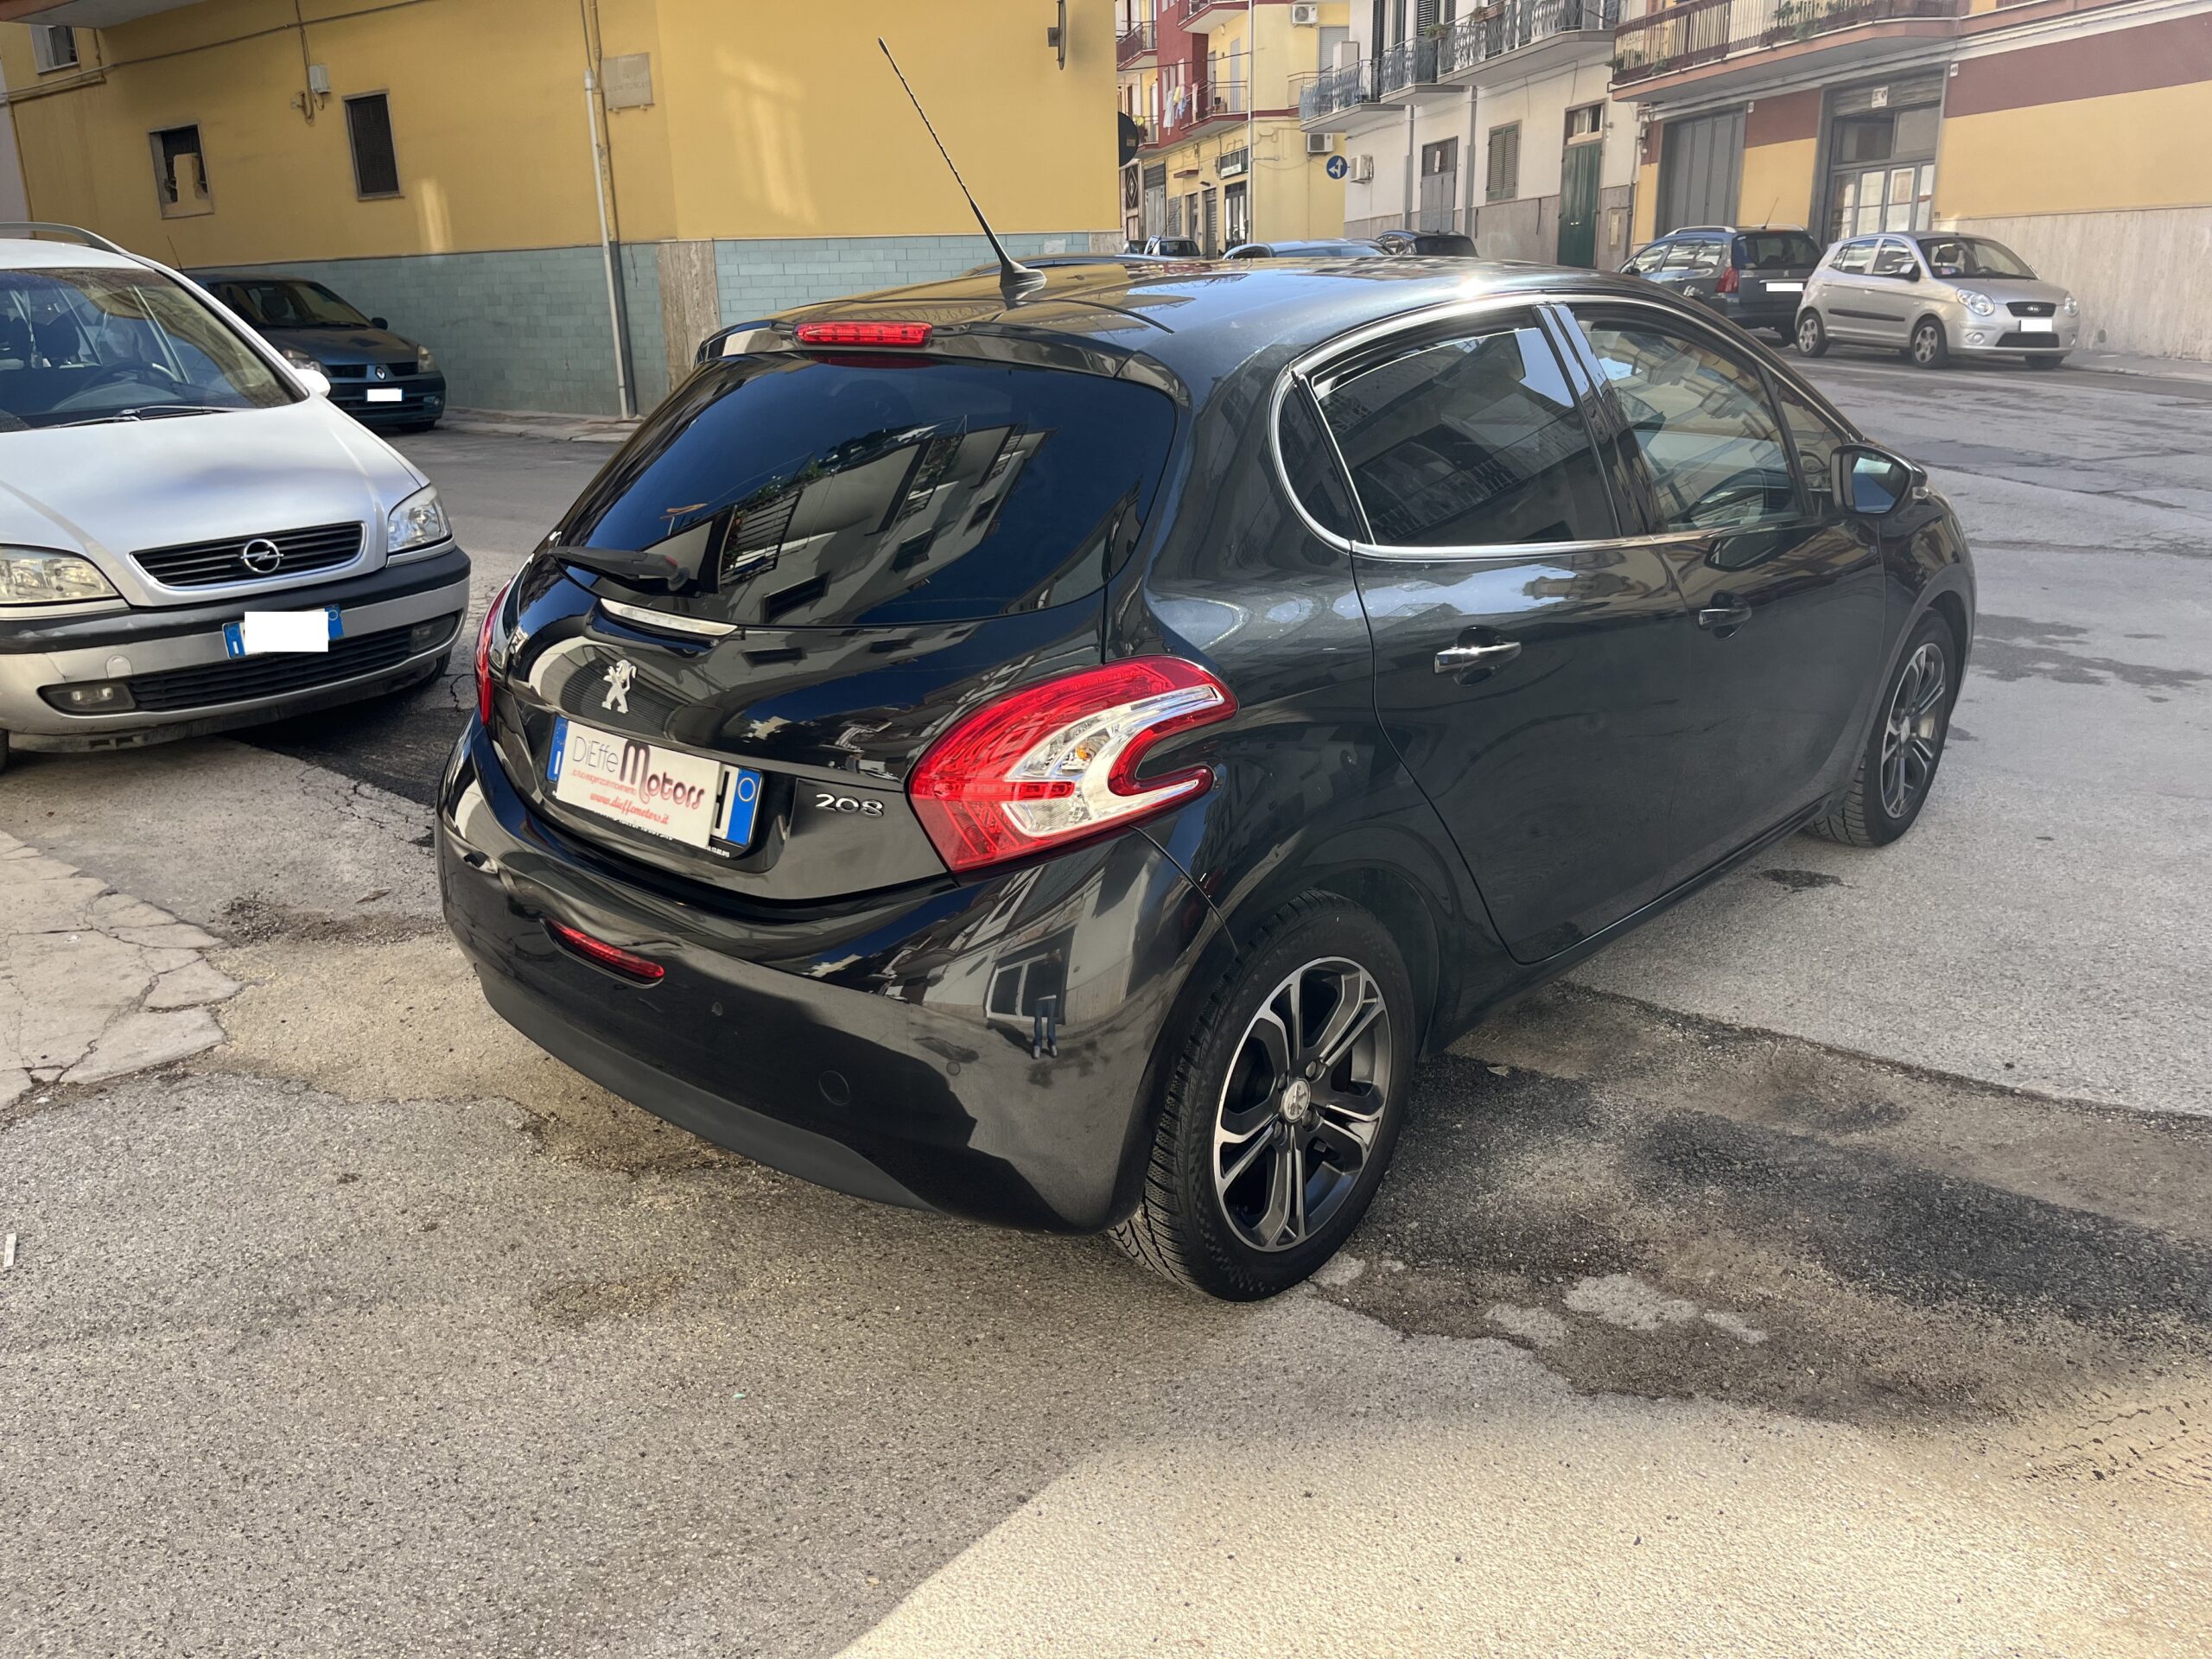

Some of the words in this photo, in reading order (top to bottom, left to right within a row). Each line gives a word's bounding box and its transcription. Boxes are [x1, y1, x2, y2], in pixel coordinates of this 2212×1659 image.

[572, 735, 619, 772] DiEffe
[620, 739, 705, 810] Motors
[815, 793, 884, 818] 208
